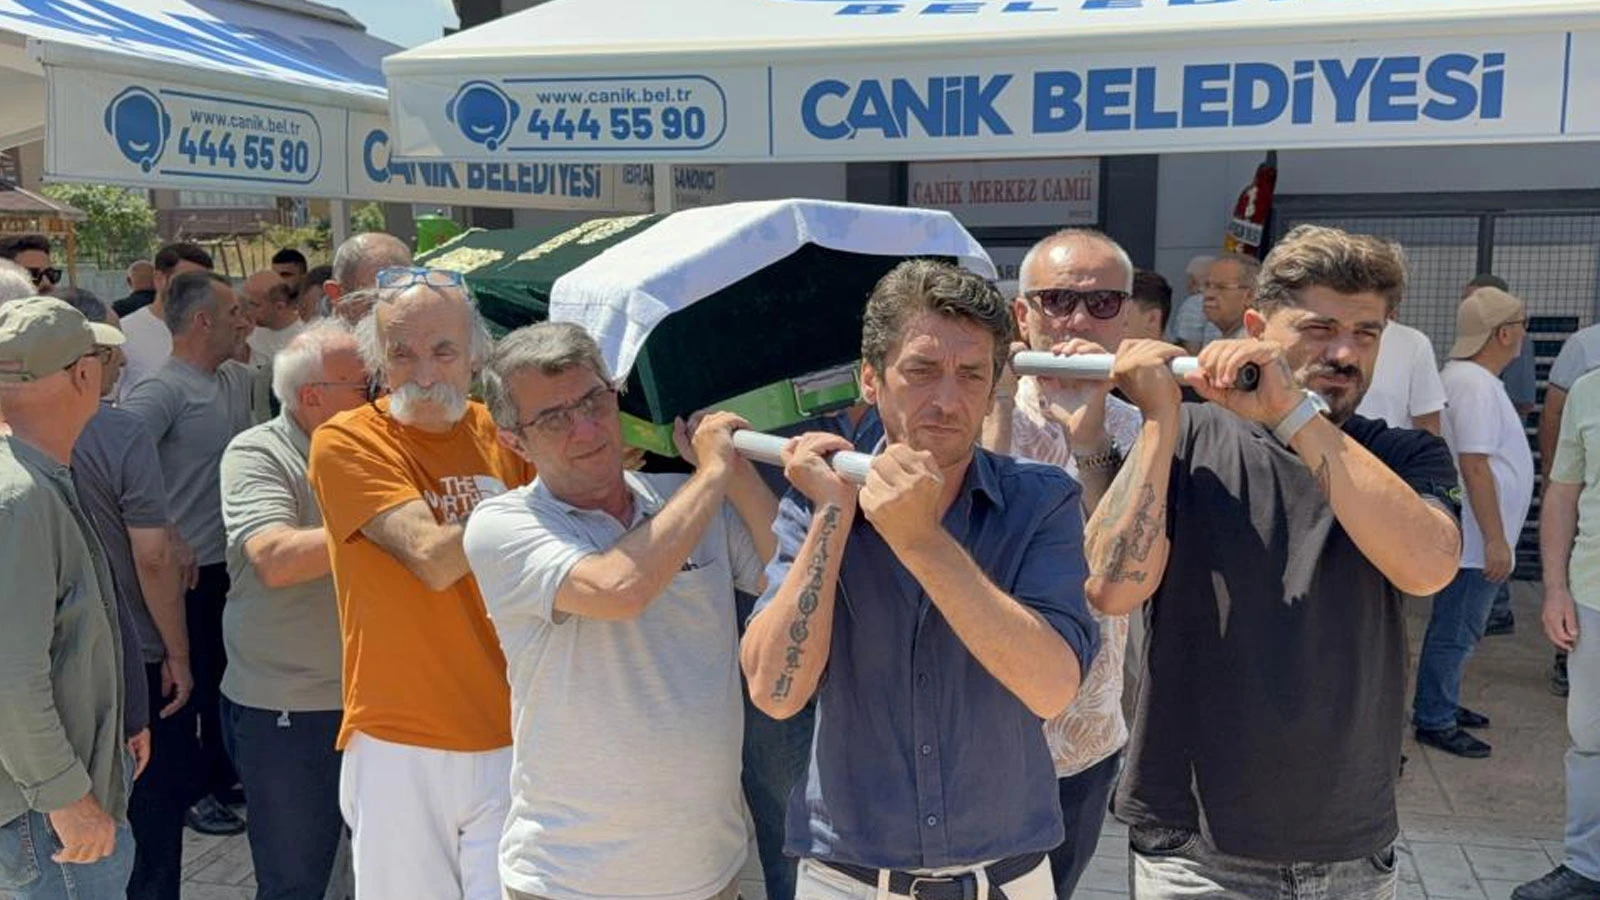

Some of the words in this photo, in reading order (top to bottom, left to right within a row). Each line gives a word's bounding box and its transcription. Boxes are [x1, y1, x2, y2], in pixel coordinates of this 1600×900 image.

[536, 87, 692, 104] www.canik.bel.tr
[801, 74, 1014, 140] CANİK
[1032, 52, 1506, 134] BELEDİYESİ
[190, 110, 301, 135] www.canik.bel.tr
[528, 108, 601, 141] 444
[610, 107, 653, 140] 55
[661, 106, 706, 140] 90
[178, 126, 237, 168] 444
[244, 134, 275, 170] 55
[280, 139, 309, 174] 90
[969, 179, 1037, 204] MERKEZ
[440, 475, 480, 495] THE
